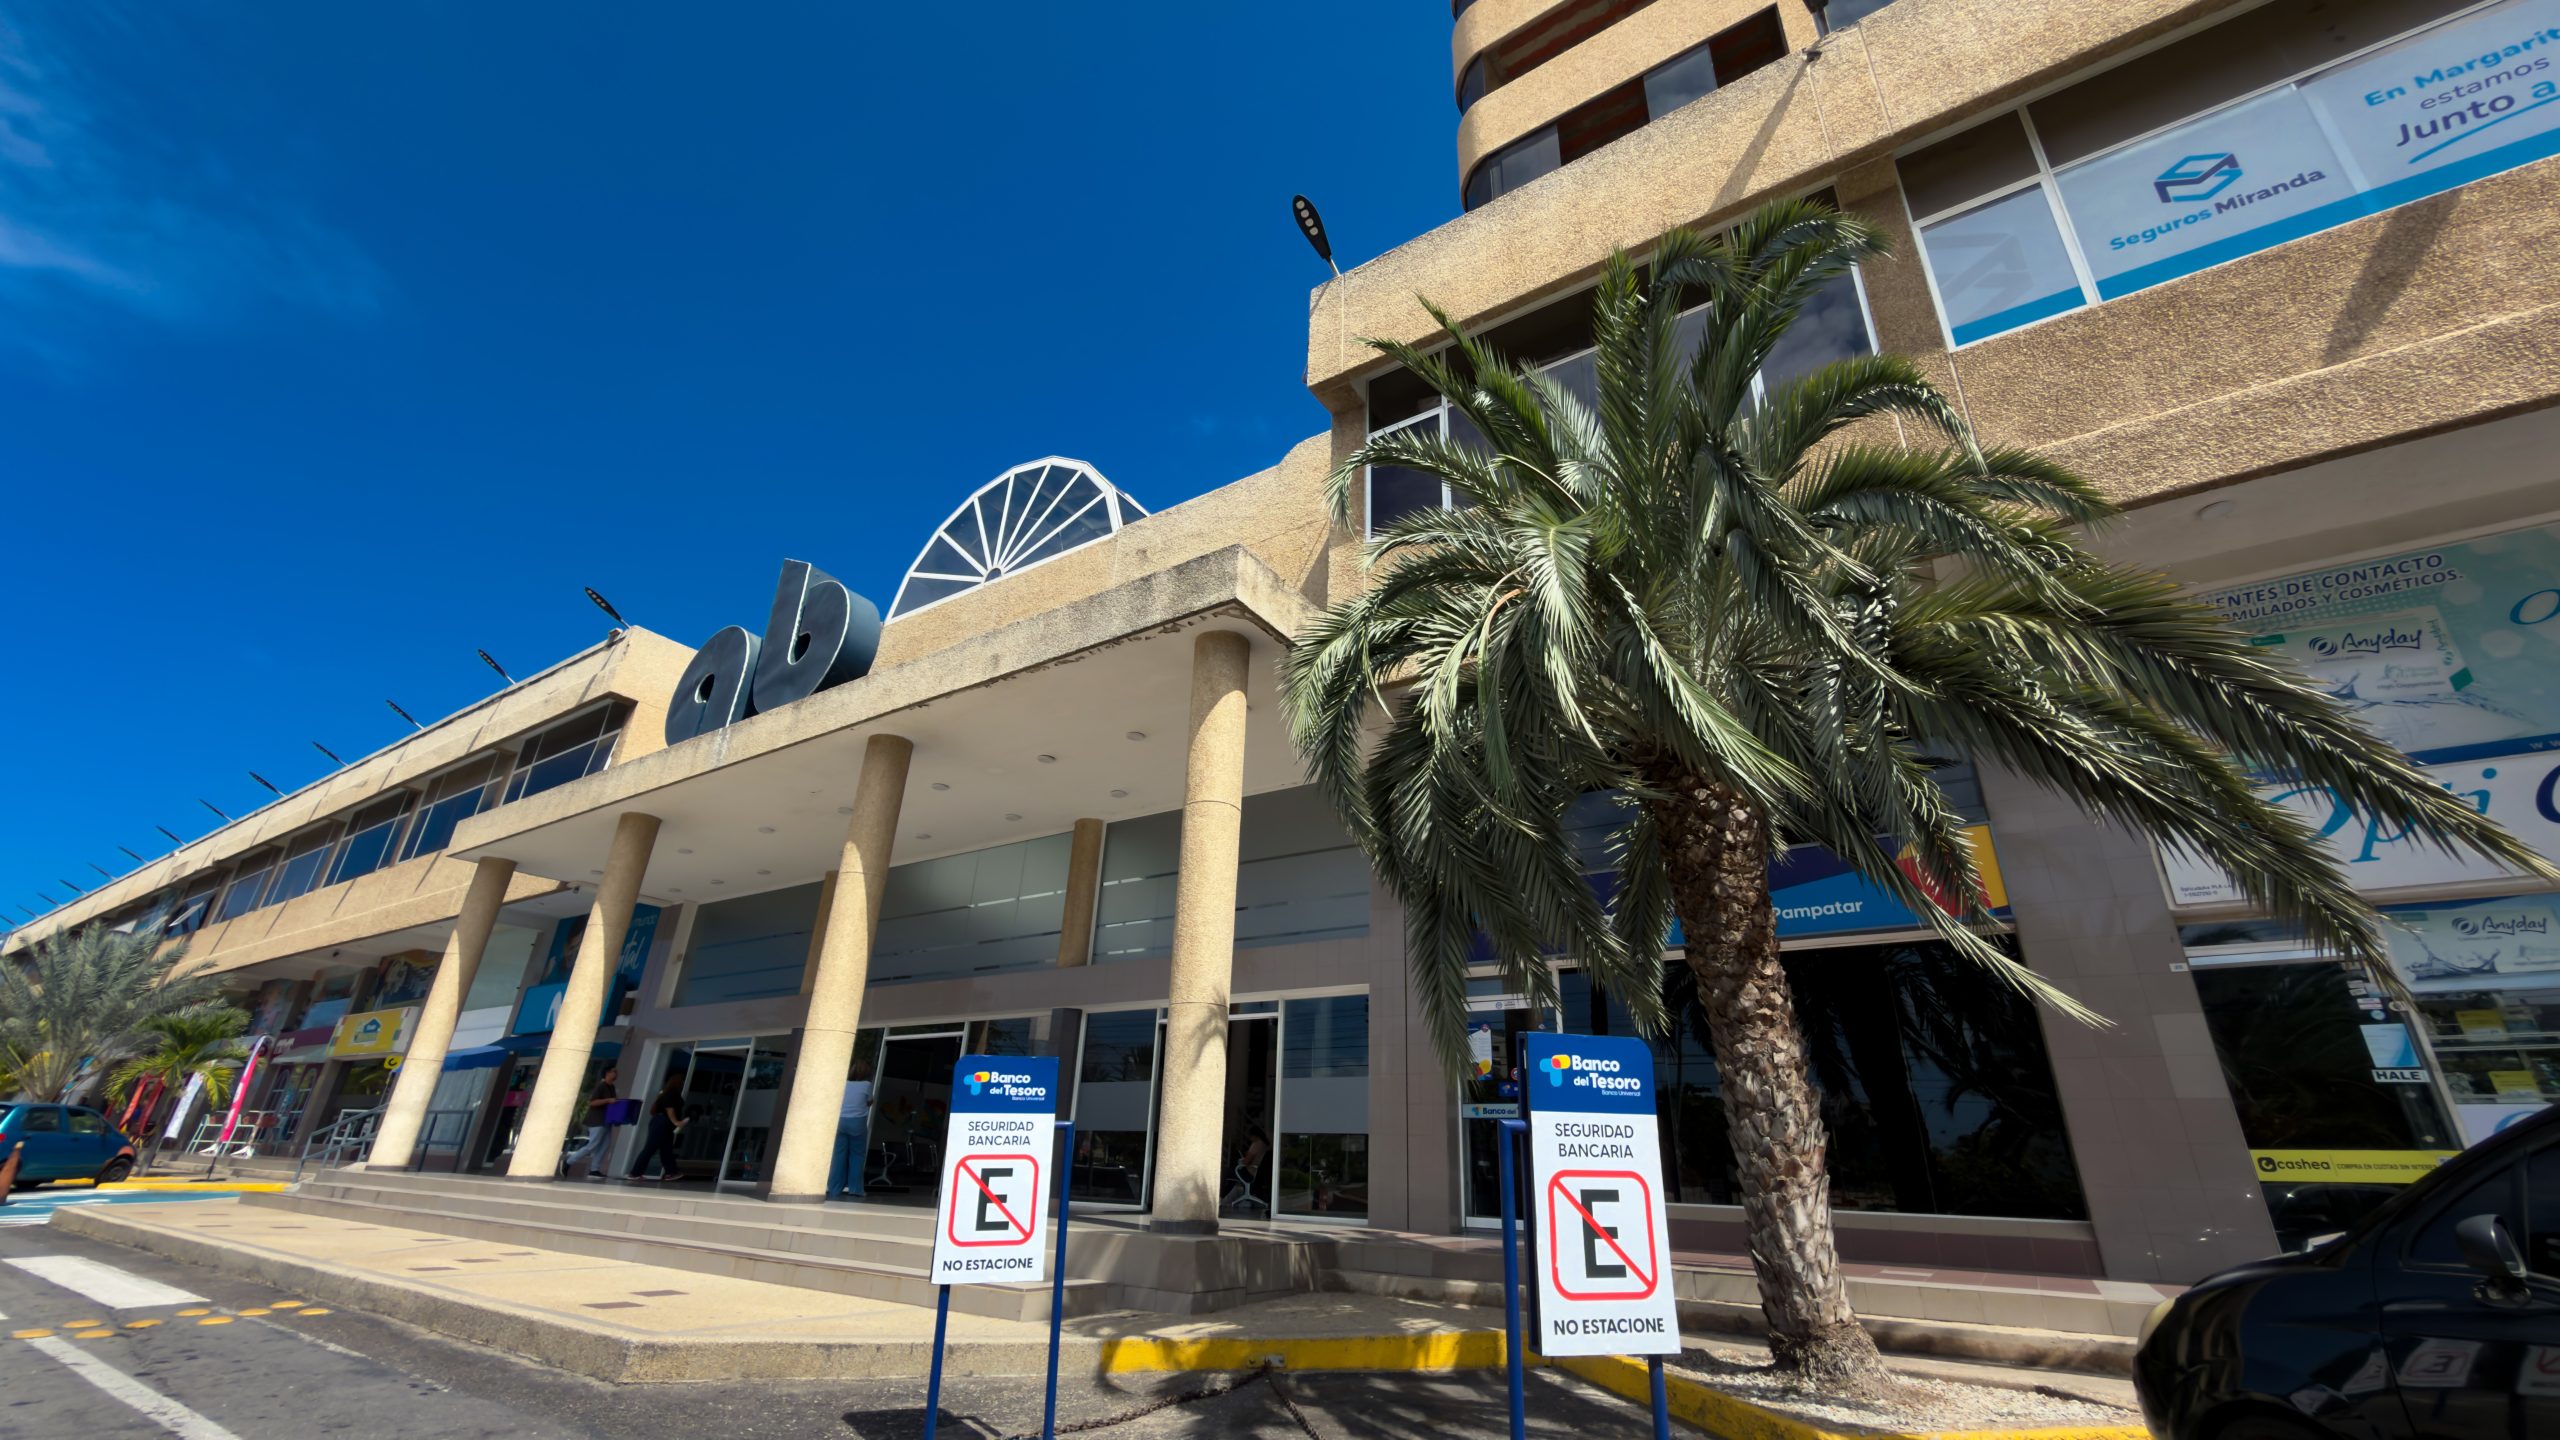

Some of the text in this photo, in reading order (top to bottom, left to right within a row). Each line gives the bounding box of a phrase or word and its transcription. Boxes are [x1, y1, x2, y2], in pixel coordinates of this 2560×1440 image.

[2420, 57, 2550, 110] estamos
[2364, 86, 2407, 106] En
[2396, 80, 2557, 147] Junto a
[2110, 169, 2327, 250] Seguros Miranda
[2287, 582, 2313, 596] DE
[2322, 554, 2443, 588] CONTACTO
[2323, 593, 2333, 604] Y
[2339, 569, 2464, 600] COSMÉTICOS.
[2341, 628, 2423, 653] Anyday
[2482, 915, 2547, 935] Anyday
[1571, 1054, 1620, 1072] Banco
[990, 1071, 1031, 1084] Banco
[1574, 1072, 1641, 1090] del Tesoro
[2375, 1071, 2421, 1081] HALE
[989, 1084, 1046, 1096] del Tesoro
[1482, 1107, 1506, 1115] Banco
[968, 1121, 1034, 1132] SEGURIDAD
[1554, 1122, 1634, 1139] SEGURIDAD
[968, 1135, 1031, 1146] BANCARIA
[1558, 1143, 1634, 1159] BANCARIA
[2278, 1159, 2331, 1170] cashea
[942, 1257, 1034, 1272] NO ESTACIONE
[1554, 1317, 1665, 1335] NO ESTACIONE
